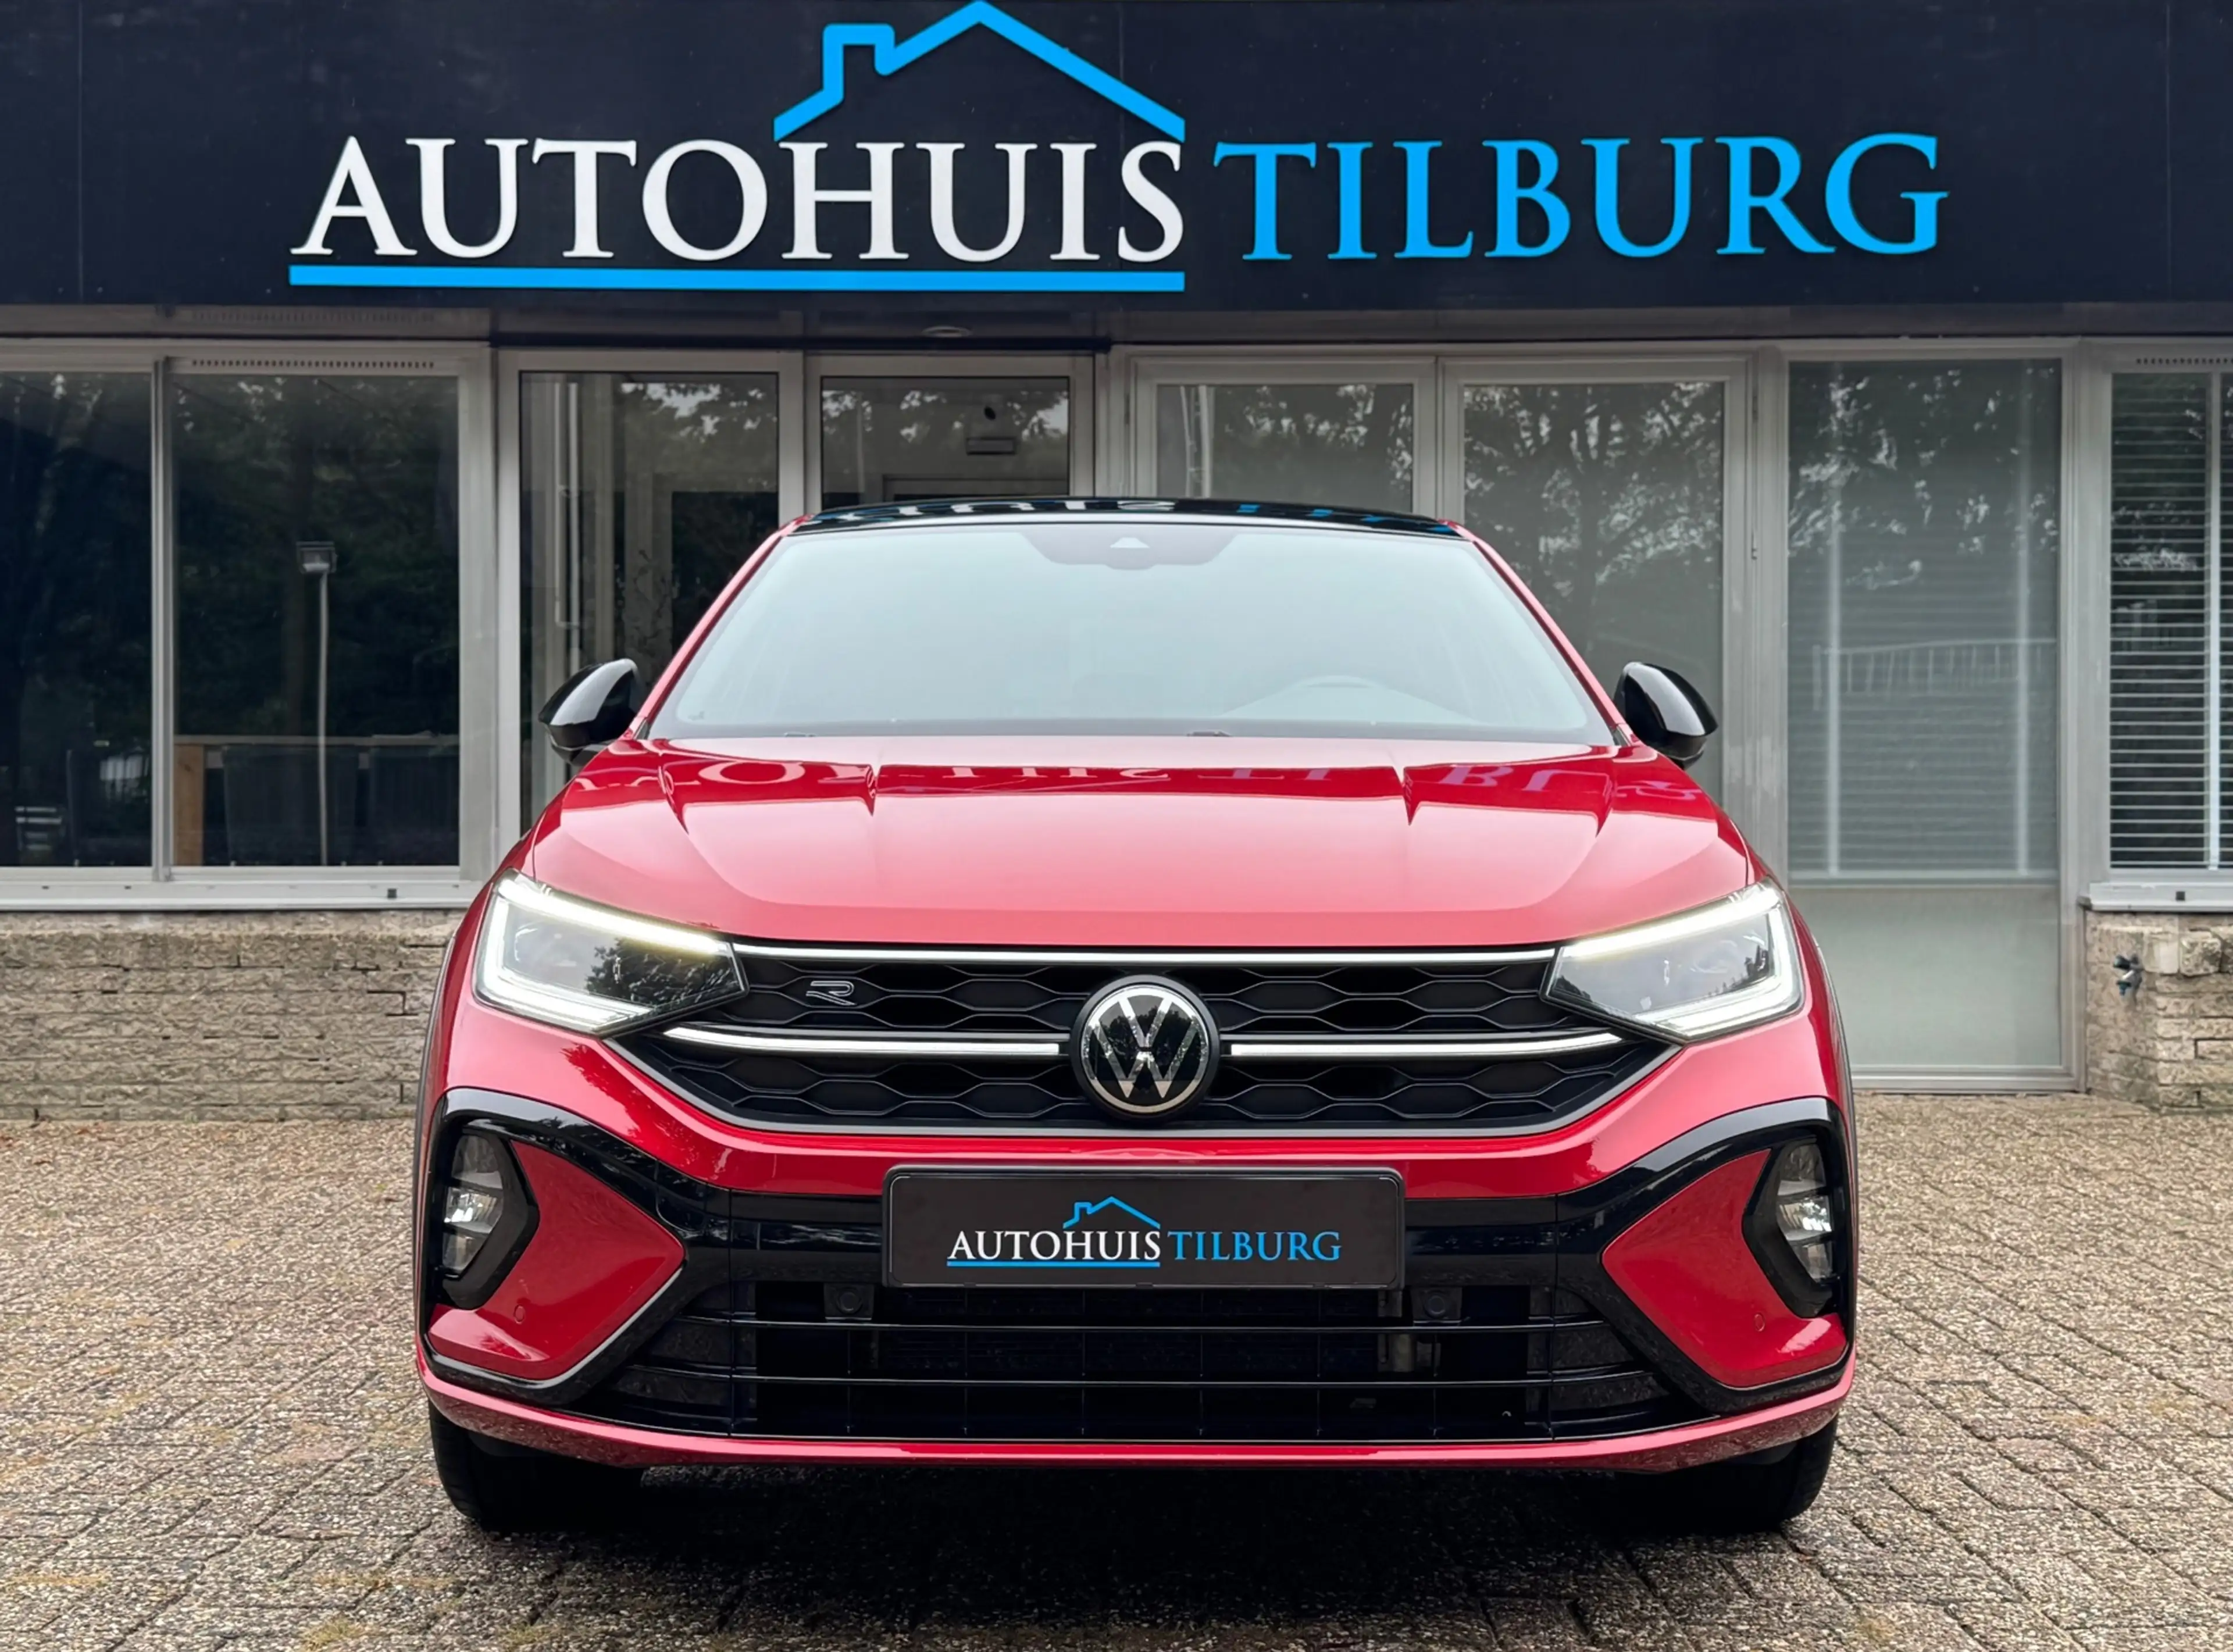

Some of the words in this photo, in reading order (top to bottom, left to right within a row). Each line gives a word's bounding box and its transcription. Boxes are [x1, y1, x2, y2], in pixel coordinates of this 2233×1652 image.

[290, 135, 1184, 262] AUTOHUIS
[1213, 133, 1949, 261] TILBURG
[947, 1230, 1161, 1261] AUTOHUIS
[1168, 1231, 1342, 1261] TILBURG
